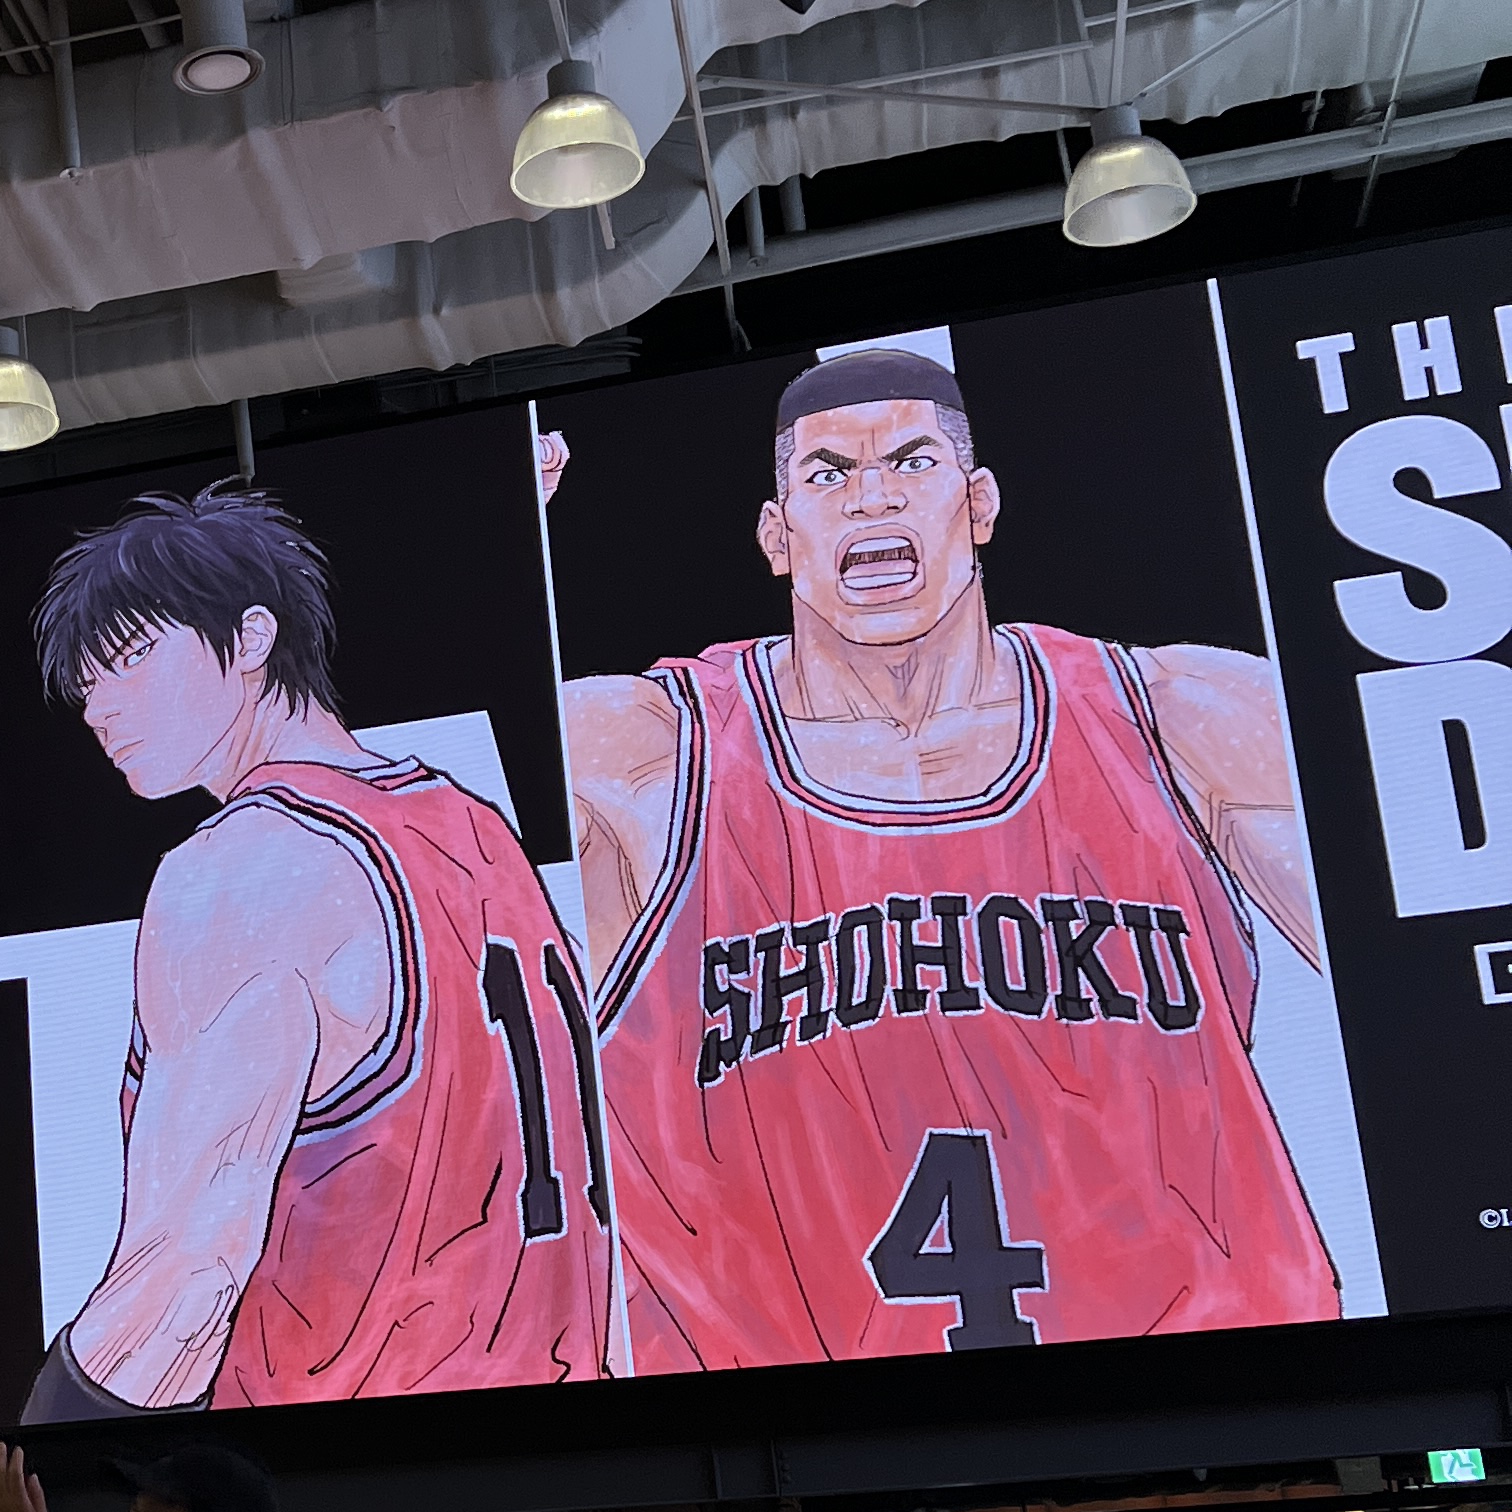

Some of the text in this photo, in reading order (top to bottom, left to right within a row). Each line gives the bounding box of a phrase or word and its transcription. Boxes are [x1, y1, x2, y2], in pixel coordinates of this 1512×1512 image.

[1294, 305, 1512, 414] TH
[695, 891, 1206, 1089] SHOHOKU
[865, 1127, 1050, 1352] 4
